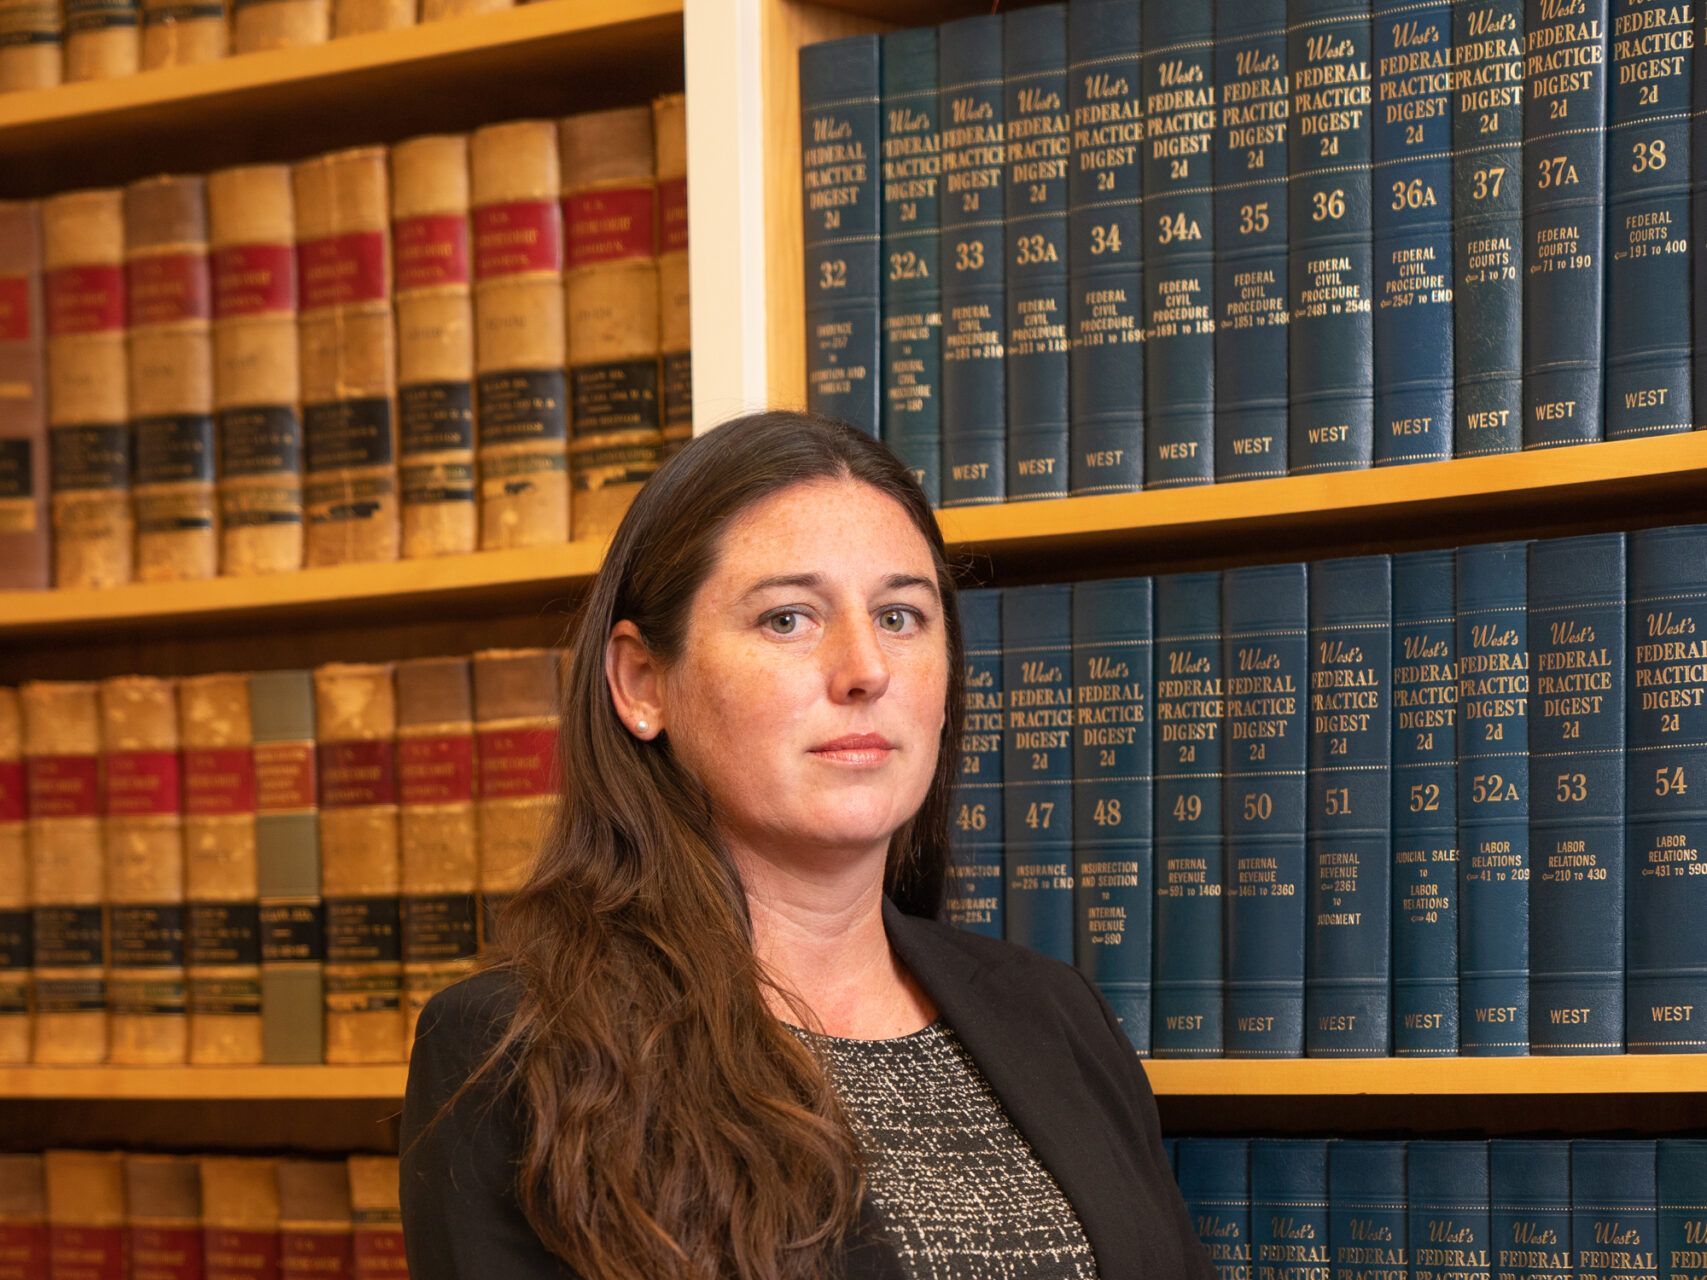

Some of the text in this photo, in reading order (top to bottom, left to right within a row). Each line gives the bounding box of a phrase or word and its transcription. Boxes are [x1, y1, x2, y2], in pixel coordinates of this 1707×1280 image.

[1540, 0, 1585, 21] West's
[1614, 4, 1695, 37] FEDERAL
[1392, 20, 1439, 48] West's
[1528, 20, 1603, 51] FEDERAL
[1613, 29, 1695, 61] PRACTICE
[1380, 48, 1454, 76] FEDERAL
[1528, 45, 1603, 76] PRACTICE
[1619, 56, 1685, 85] DIGEST
[1379, 73, 1454, 101] PRACTICE
[1533, 71, 1593, 98] DIGEST
[1639, 84, 1659, 105] 2d
[1386, 98, 1447, 124] DIGEST
[1550, 99, 1568, 119] 2d
[1406, 125, 1424, 144] 2d
[1632, 139, 1666, 173] 38
[1538, 156, 1579, 189] 37A
[1392, 178, 1437, 211] 36A
[1312, 189, 1345, 222] 36
[1158, 212, 1202, 244] 34A
[1626, 211, 1673, 229] FEDERAL
[1537, 226, 1579, 243] FEDERAL
[1629, 227, 1668, 244] COURTS
[1392, 247, 1436, 264] FEDERAL
[1539, 241, 1577, 257] COURTS
[1629, 246, 1647, 259] 191
[1665, 239, 1687, 253] 400
[1400, 263, 1426, 277] CIVIL
[1543, 258, 1553, 272] 71
[1570, 255, 1592, 268] 190
[1386, 275, 1444, 293] PROCEDURE
[1392, 294, 1414, 308] 2547
[1432, 289, 1453, 302] END
[1625, 389, 1668, 409] WEST
[1535, 401, 1576, 421] WEST
[1392, 418, 1432, 436] WEST
[1550, 621, 1595, 645] West's
[1647, 611, 1696, 637] West's
[1471, 624, 1519, 648] West's
[1538, 648, 1612, 672] FEDERAL
[1538, 671, 1612, 695] PRACTICE
[1466, 698, 1528, 720] DIGEST
[1544, 696, 1602, 717] DIGEST
[1642, 688, 1704, 710] DIGEST
[1485, 723, 1503, 741] 2d
[1562, 720, 1579, 739] 2d
[1661, 714, 1680, 732] 2d
[1472, 773, 1520, 803] 52A
[1556, 773, 1588, 802] 53
[1655, 766, 1688, 796] 54
[1243, 793, 1273, 821] 50
[1325, 787, 1352, 816] 51
[1480, 841, 1510, 854] LABOR
[1557, 840, 1585, 853] LABOR
[1656, 834, 1686, 848] LABOR
[1472, 854, 1522, 869] RELATIONS
[1548, 854, 1596, 868] RELATIONS
[1648, 849, 1698, 863] RELATIONS
[1480, 870, 1492, 881] 41
[1511, 868, 1531, 881] 209
[1555, 870, 1570, 882] 210
[1587, 868, 1607, 881] 430
[1655, 865, 1671, 877] 431
[1688, 863, 1707, 876] 590
[1475, 1007, 1517, 1023] WEST
[1550, 1008, 1590, 1024] WEST
[1651, 1005, 1693, 1022] WEST
[1429, 1221, 1474, 1243] West's
[1594, 1221, 1640, 1245] West's
[1416, 1249, 1491, 1267] FEDERAL
[1579, 1250, 1658, 1270] FEDERAL
